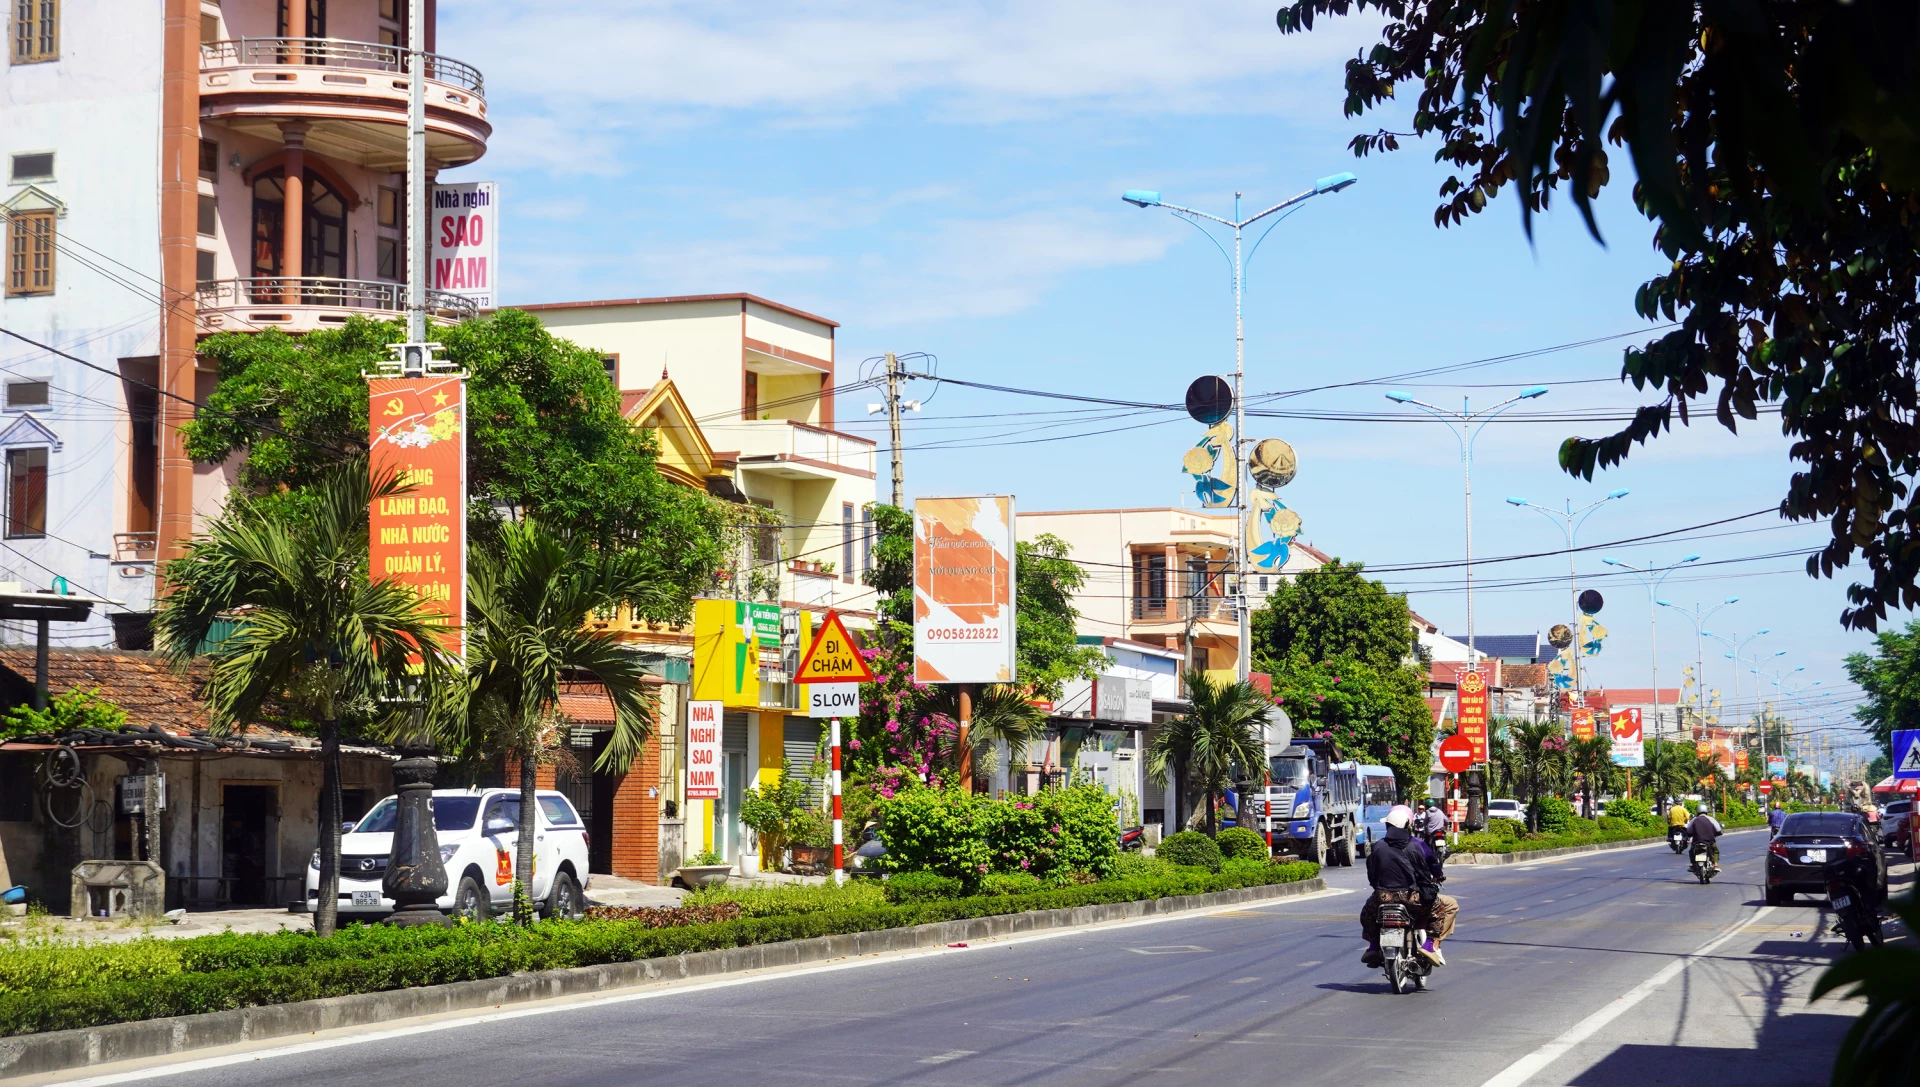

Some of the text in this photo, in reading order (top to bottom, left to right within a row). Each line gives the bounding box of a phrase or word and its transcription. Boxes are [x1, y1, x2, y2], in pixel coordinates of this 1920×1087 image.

[435, 185, 490, 209] Nhà nghỉ
[440, 214, 484, 248] SAO
[435, 257, 487, 290] NAM
[419, 496, 450, 518] ĐẠO,
[380, 522, 450, 545] NHÀ NƯỚC
[385, 550, 446, 575] QUẢN LÝ,
[979, 564, 997, 575] CÁO
[927, 627, 999, 640] 0905822822
[825, 640, 840, 654] ĐI
[812, 656, 853, 675] CHẬM
[812, 693, 856, 707] SLOW
[692, 703, 715, 722] NHÀ
[690, 723, 716, 743] NGHỈ
[692, 749, 713, 765] SAO
[690, 771, 715, 786] NAM
[359, 891, 373, 899] 49A
